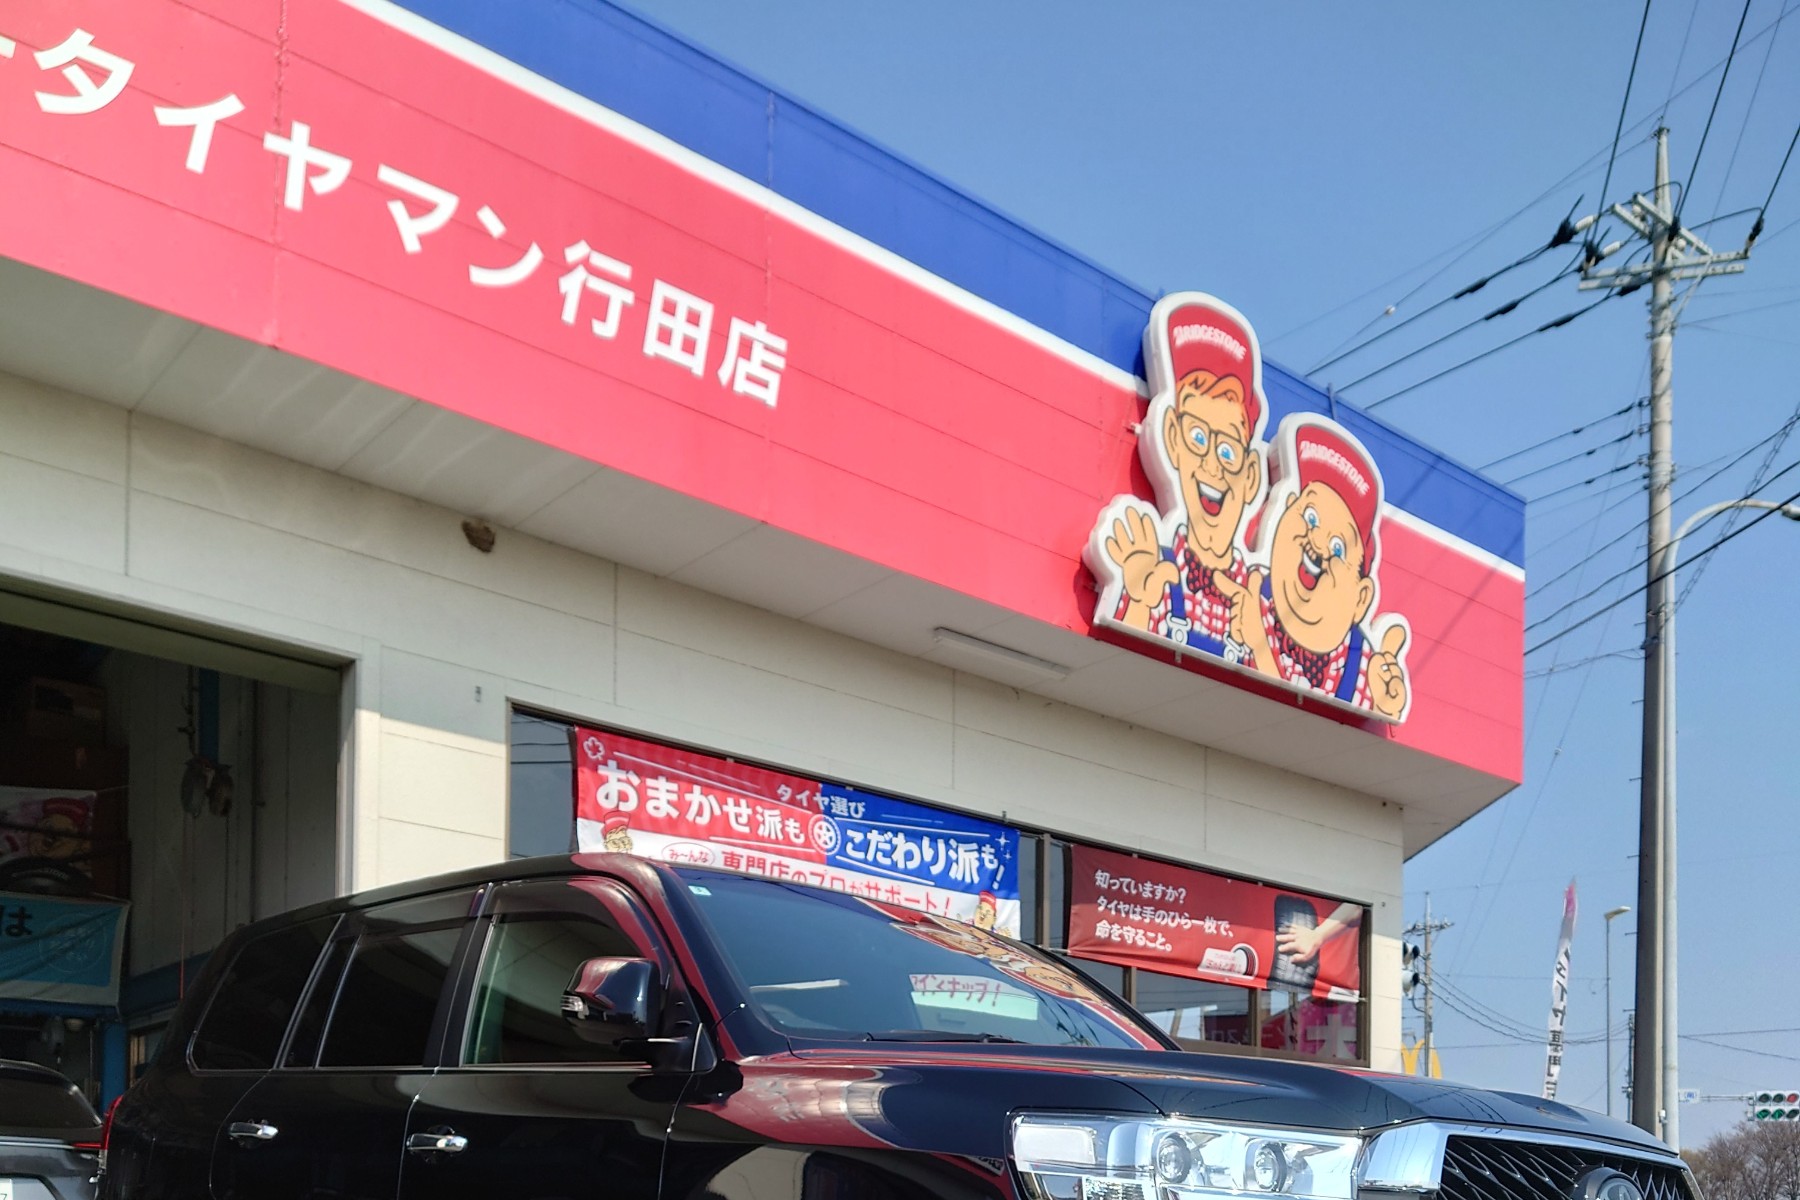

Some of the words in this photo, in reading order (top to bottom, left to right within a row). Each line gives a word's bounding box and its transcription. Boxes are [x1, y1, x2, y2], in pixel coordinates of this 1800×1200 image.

[0, 27, 788, 407] タイヤマン行田店
[1172, 323, 1247, 360] BRIDGESTONE
[1300, 440, 1370, 495] BRIDGESTONE
[596, 760, 805, 843] おまかせ派も
[777, 784, 866, 818] タイヤ選び
[1095, 920, 1173, 953] 命を守ること。
